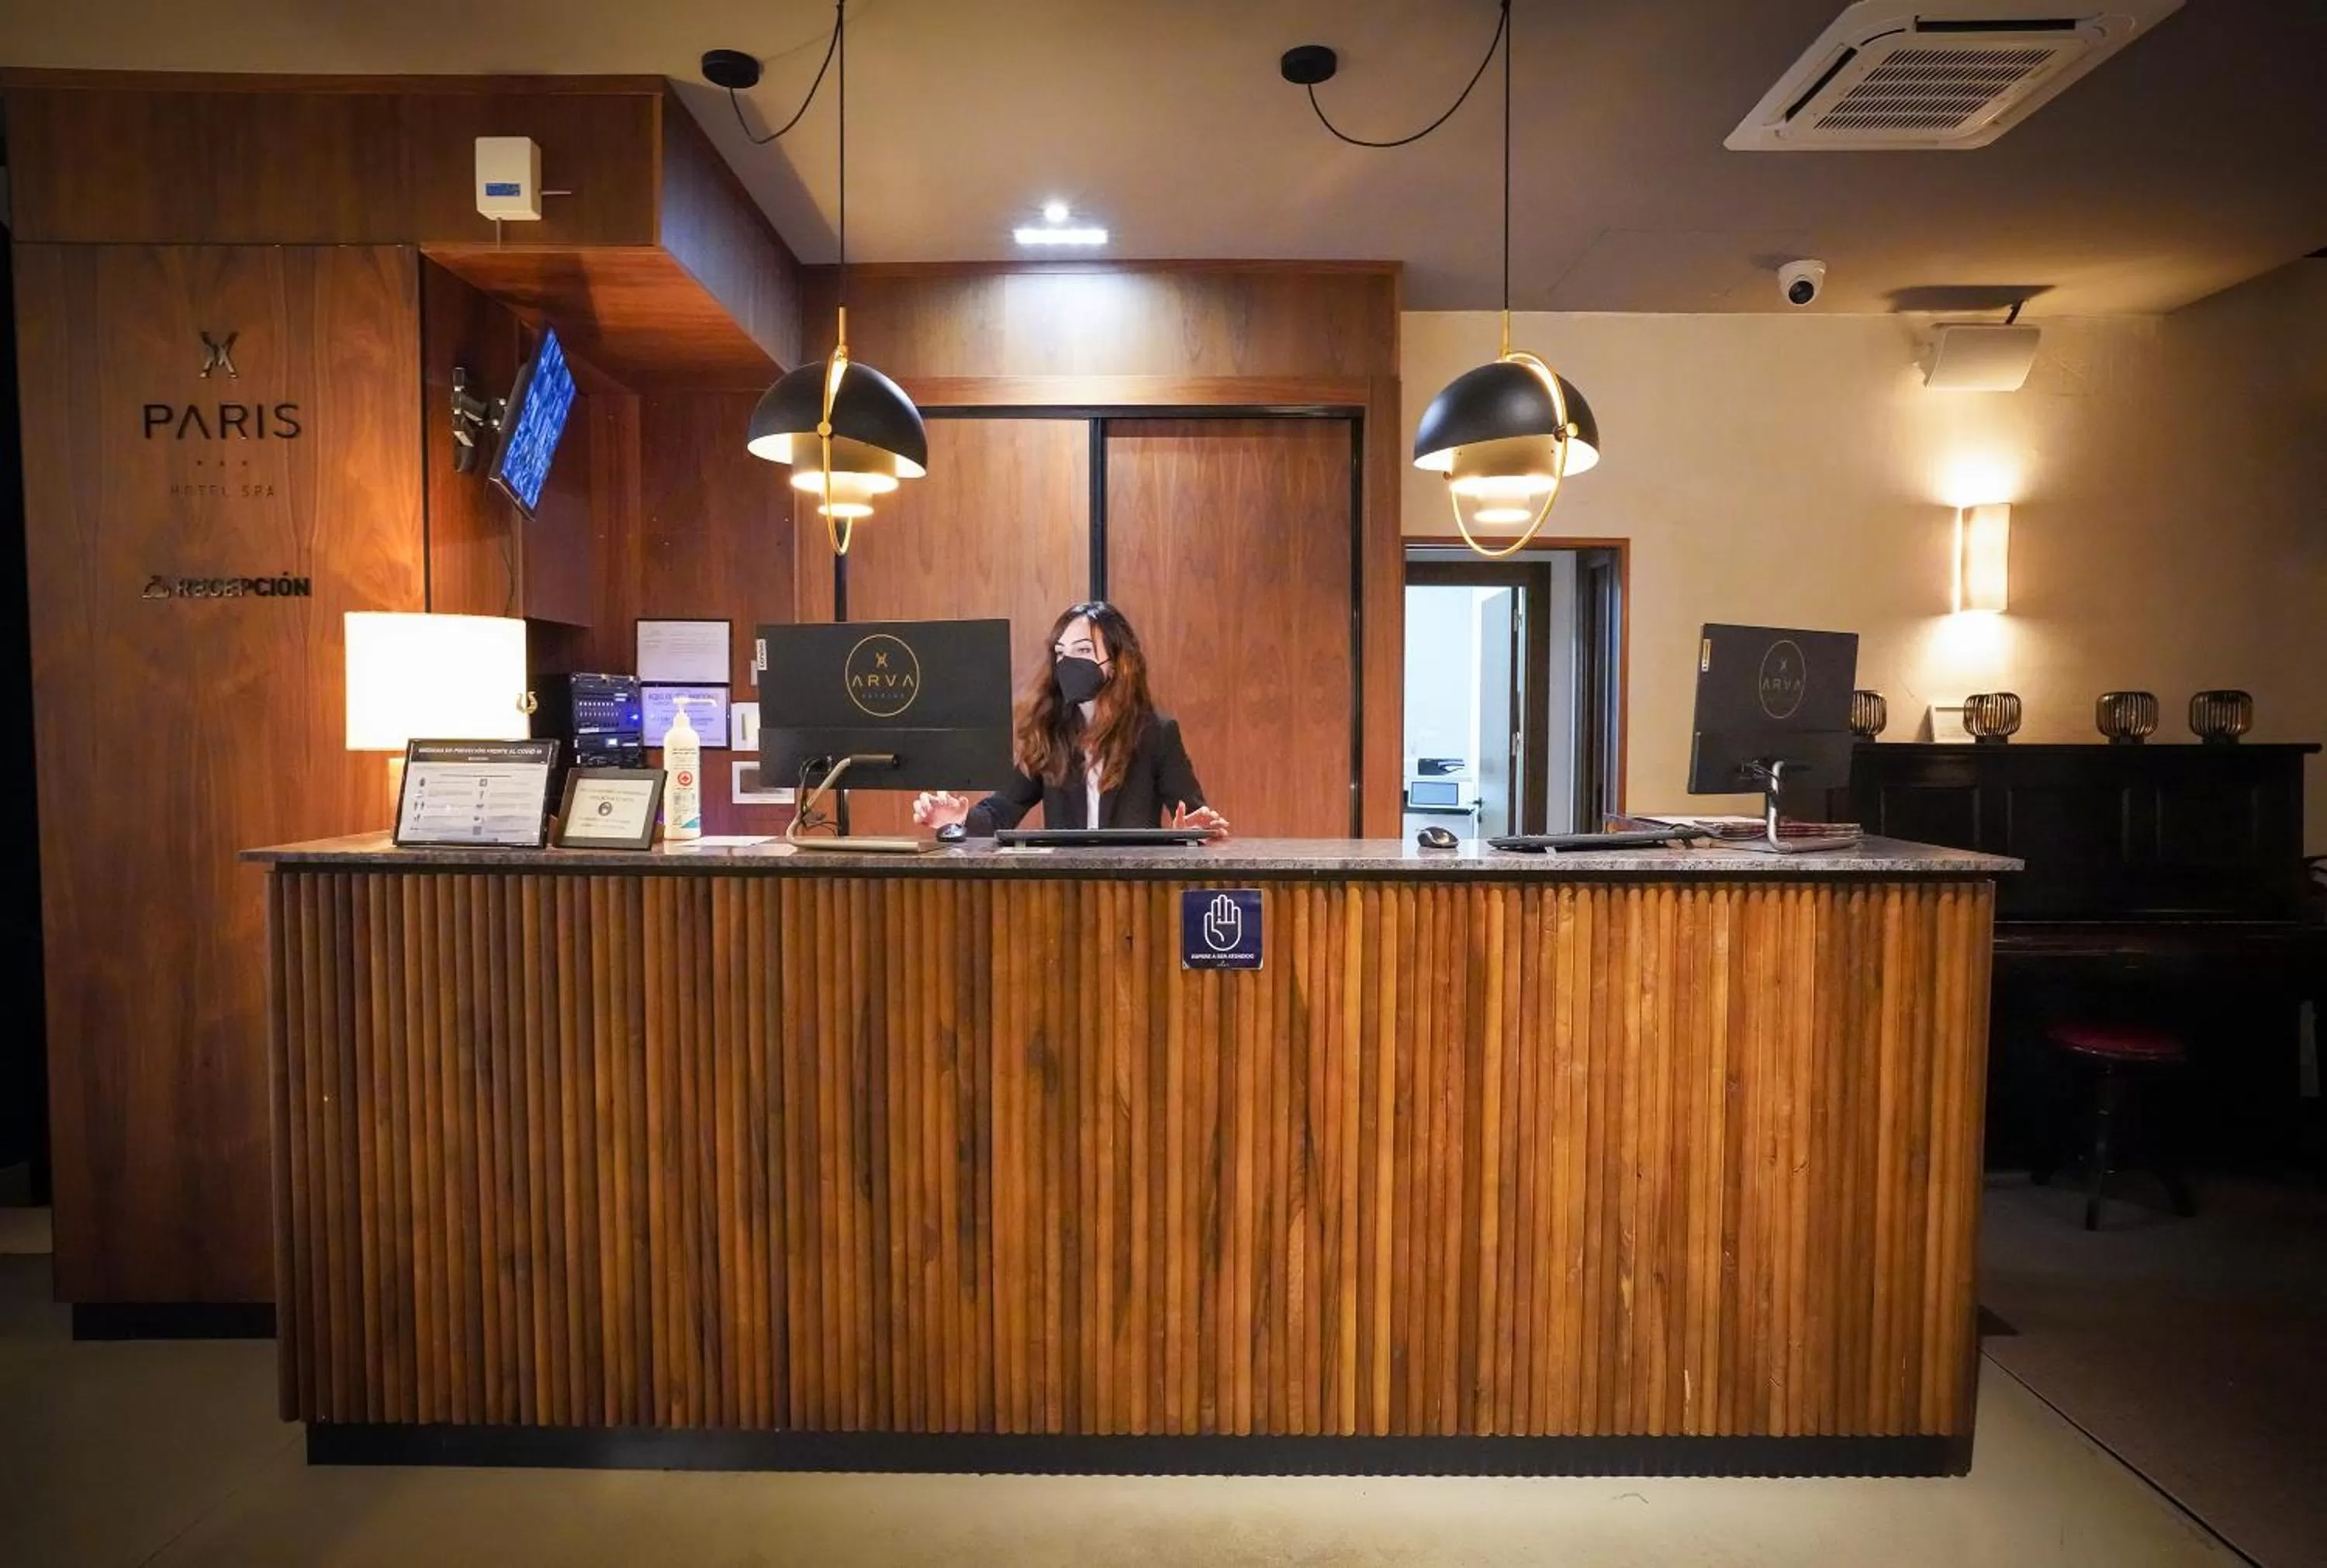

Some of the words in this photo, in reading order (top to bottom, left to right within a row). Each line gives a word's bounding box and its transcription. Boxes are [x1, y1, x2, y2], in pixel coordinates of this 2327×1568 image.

[143, 402, 303, 440] PARIS
[241, 484, 275, 498] SPA
[175, 571, 311, 597] RECEPCIÓN
[852, 673, 915, 688] ARVA
[1762, 678, 1800, 691] ARVA
